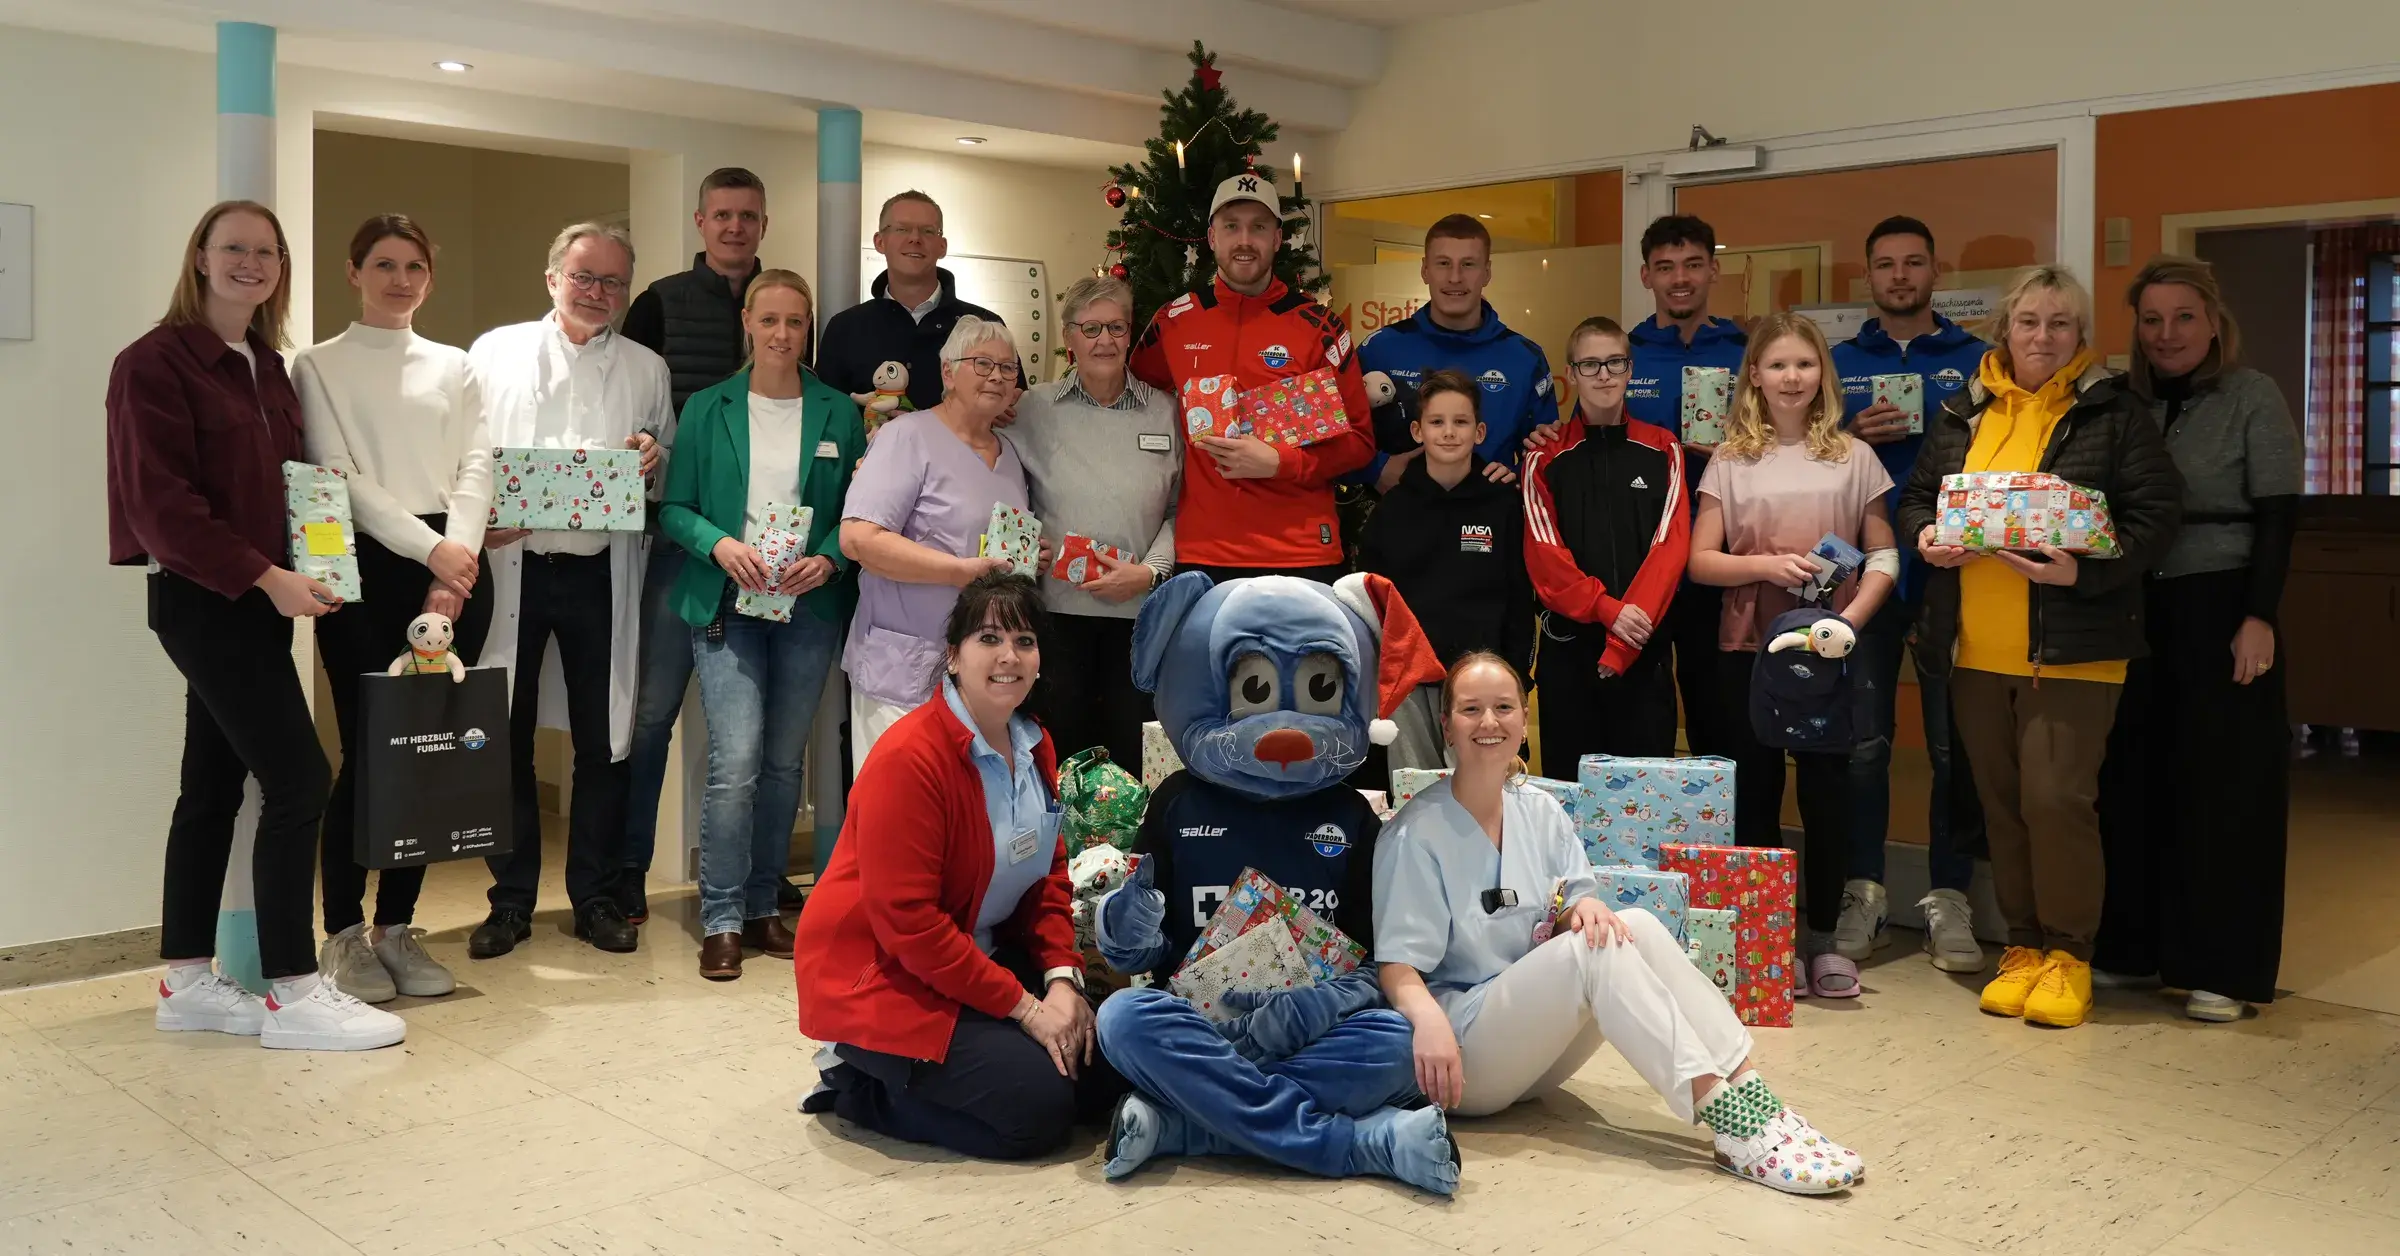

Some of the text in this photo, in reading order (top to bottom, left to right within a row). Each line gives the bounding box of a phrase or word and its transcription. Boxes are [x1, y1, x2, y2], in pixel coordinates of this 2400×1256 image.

[1461, 525, 1492, 535] NASA
[390, 732, 456, 746] MIT HERZBLUT.
[1305, 833, 1343, 842] PADERBORN
[1324, 845, 1333, 853] 07
